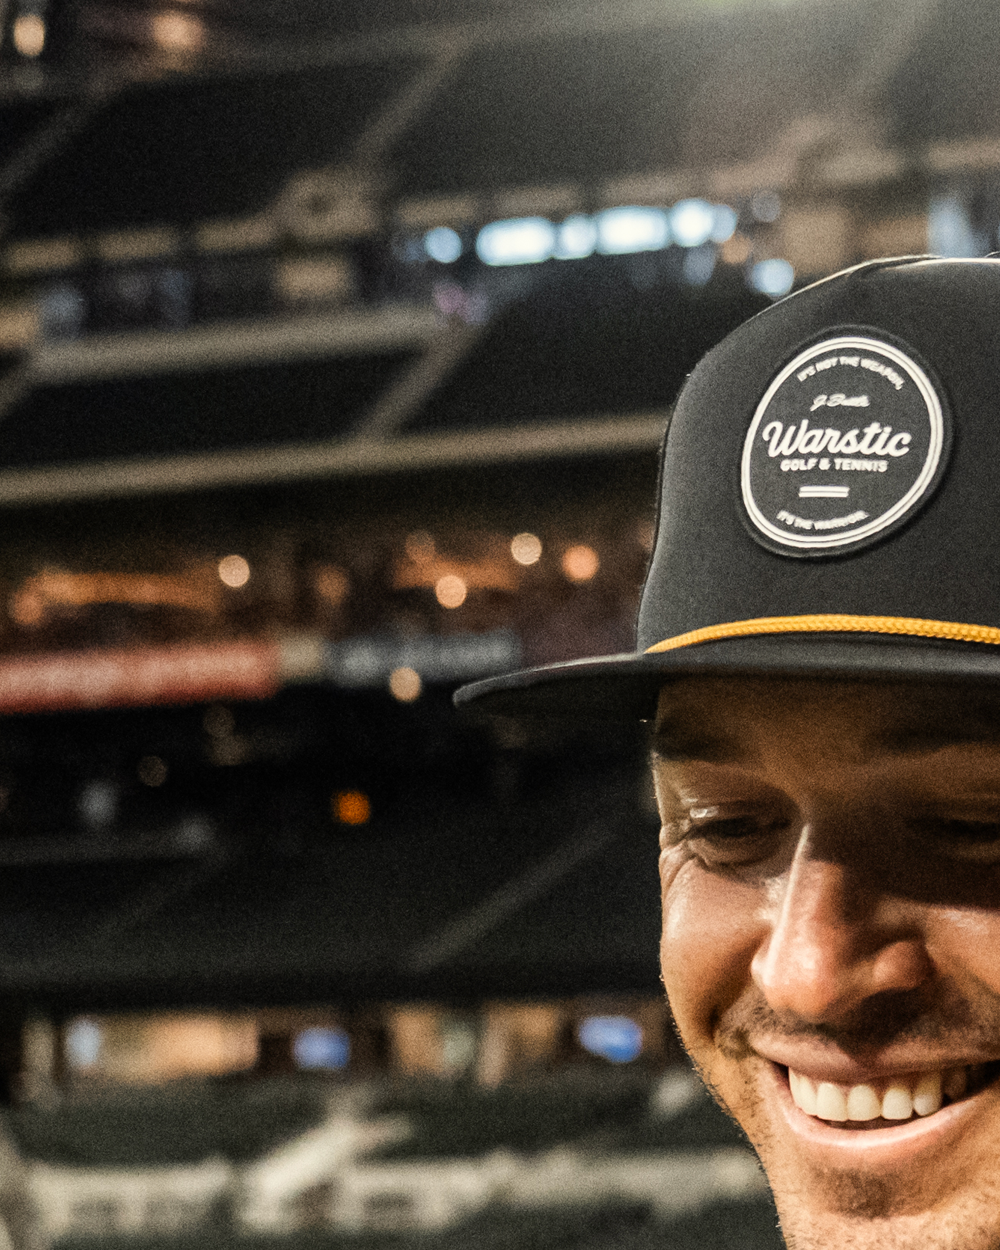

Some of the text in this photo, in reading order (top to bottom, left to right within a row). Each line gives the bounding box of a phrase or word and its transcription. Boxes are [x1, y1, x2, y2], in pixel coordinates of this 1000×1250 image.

[815, 357, 839, 372] NOT
[762, 419, 912, 457] Warstic
[780, 458, 889, 473] GOLF & TENNIS
